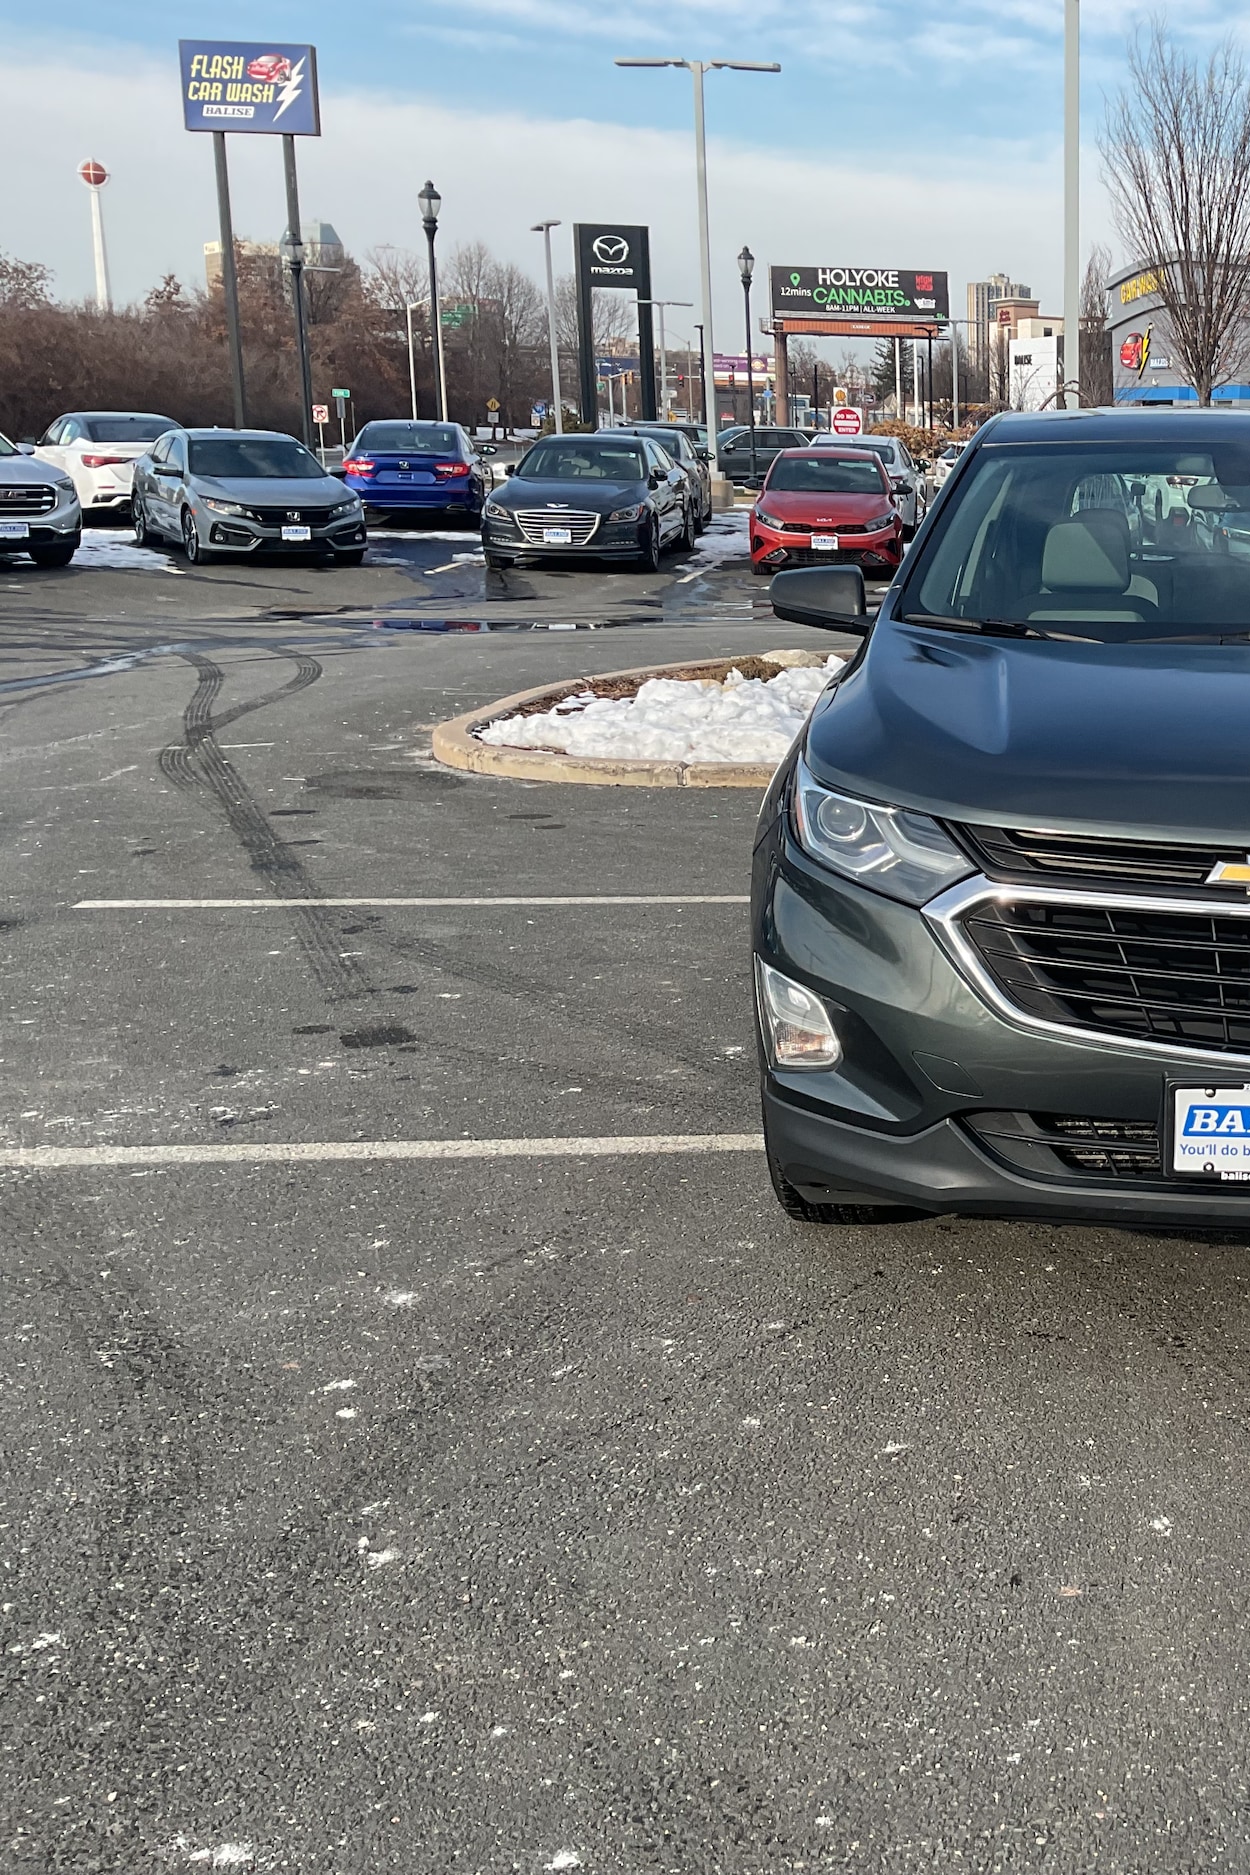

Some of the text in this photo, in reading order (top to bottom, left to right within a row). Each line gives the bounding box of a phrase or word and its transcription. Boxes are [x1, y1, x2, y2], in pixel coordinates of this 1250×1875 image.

[190, 54, 244, 79] FLASH
[188, 81, 275, 103] CAR WASH
[205, 106, 253, 117] BALISE
[817, 268, 899, 287] HOLYOKE
[780, 286, 812, 297] 12mins
[1120, 279, 1137, 304] CAR
[825, 304, 896, 314] 8AM-11PM ALL-WEEK
[1179, 1143, 1217, 1156] You'll
[1221, 1144, 1238, 1156] do
